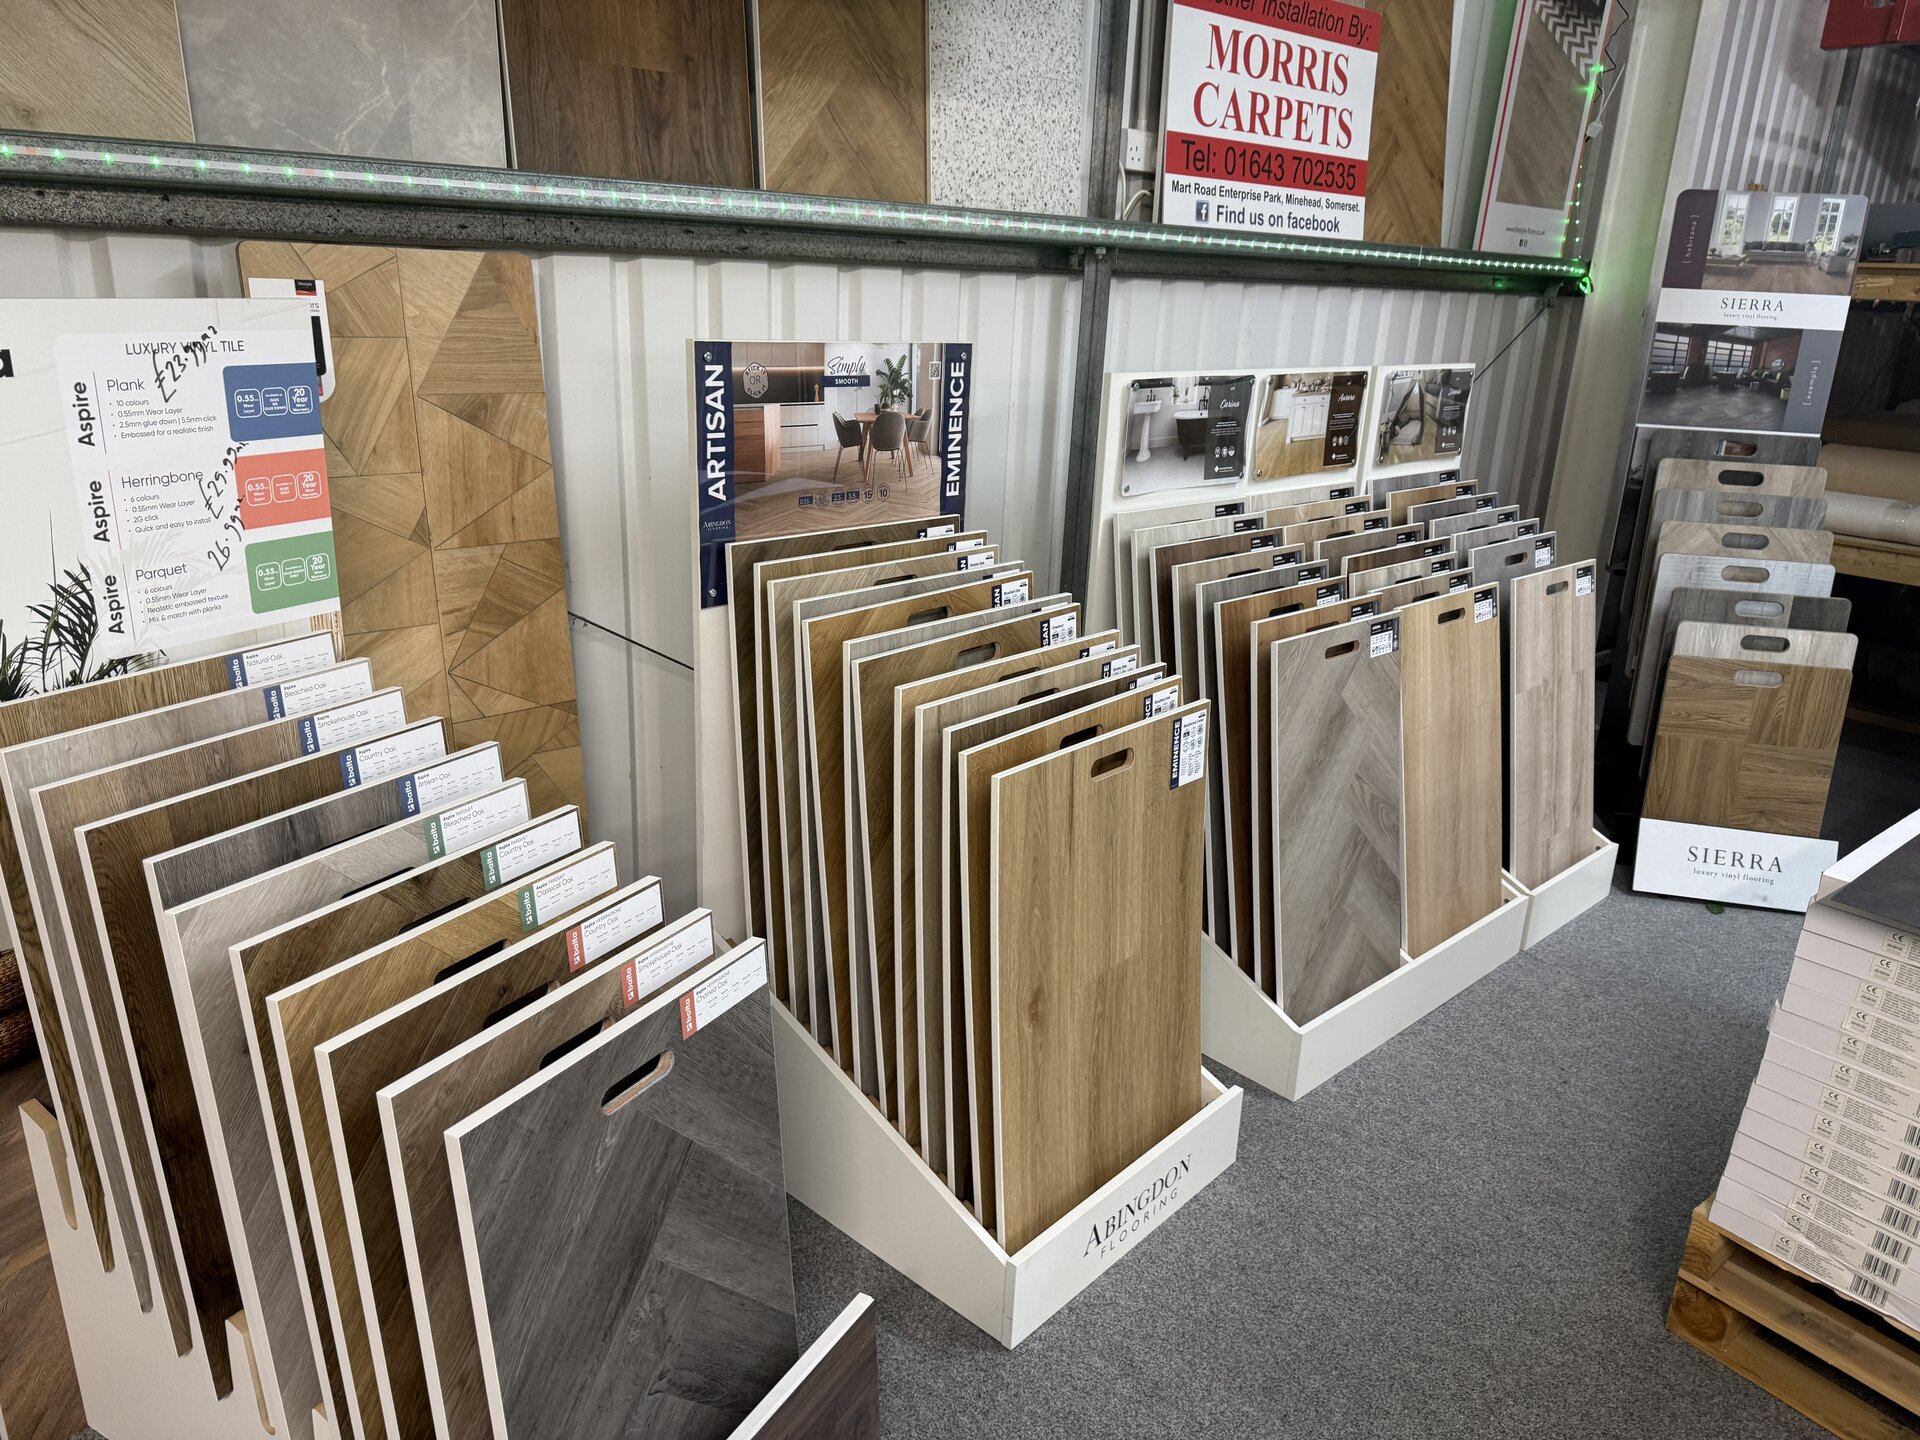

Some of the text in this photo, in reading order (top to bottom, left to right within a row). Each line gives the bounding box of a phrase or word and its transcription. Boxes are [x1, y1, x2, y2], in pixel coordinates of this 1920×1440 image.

[1261, 0, 1372, 45] Installation By:
[1206, 23, 1350, 96] MORRIS
[1193, 81, 1353, 150] CARPETS
[1181, 139, 1356, 191] Tel: 01643 702535
[1171, 180, 1361, 213] Mart Road Enterprise Park, Minehead, Somerset.
[1216, 204, 1340, 233] Find us on facebook
[1720, 297, 1784, 312] SIERRA
[125, 342, 177, 355] LUXURY
[219, 340, 245, 352] TILE
[827, 355, 866, 377] Simply
[106, 378, 146, 392] Plank
[749, 375, 761, 385] OR
[125, 399, 150, 407] colours
[292, 387, 309, 403] 20 Year
[72, 381, 96, 447] Aspire
[117, 407, 183, 418] 0.55mm Wear Layer
[119, 414, 217, 429] 2.5mm glue down 5.5mm click
[120, 430, 156, 439] Embossed
[172, 427, 197, 435] realistic
[197, 425, 214, 433] finish
[704, 364, 727, 501] ARTISAN
[946, 361, 965, 497] EMINENCE
[121, 471, 204, 489] Herringbone
[301, 474, 317, 489] 20 Year
[135, 493, 160, 502] colours
[880, 489, 888, 498] 10
[88, 480, 110, 543] Aspire
[131, 499, 196, 513] 0.55mm Wear Layer
[133, 514, 159, 524] 2G click
[134, 524, 154, 534] Quick
[155, 522, 169, 530] and
[169, 521, 185, 530] easy
[193, 517, 212, 525] install
[135, 563, 188, 581] Parquet
[310, 556, 326, 572] 20 Year
[145, 588, 207, 604] 0.55mm Wear Layer
[149, 585, 173, 593] colours
[103, 575, 125, 634] Aspire
[147, 593, 229, 614] Realistic embossed texture
[148, 616, 161, 624] Mix
[166, 610, 188, 620] match
[188, 608, 202, 616] with
[202, 604, 222, 614] planks
[233, 659, 242, 683] balta
[246, 654, 283, 667] Natural Oak
[270, 690, 280, 714] balta
[284, 686, 313, 698] Bleached
[317, 709, 369, 728] Smokehouse Oak
[304, 721, 314, 745] balta
[359, 745, 397, 762] Country Oak
[1171, 720, 1181, 779] EMINENCE
[346, 755, 355, 779] balta
[417, 772, 451, 788] Artisan Oak
[405, 780, 414, 804] balta
[443, 808, 485, 829] Bleached Oak
[430, 822, 440, 847] balta
[499, 838, 535, 858] Country Oak
[486, 852, 495, 876] balta
[1687, 845, 1784, 874] SIERRA
[536, 876, 574, 898] Classical Oak
[1693, 867, 1775, 886] luxury vinyl flooring
[524, 892, 532, 916] balta
[584, 923, 607, 938] Country
[606, 915, 619, 926] Oak
[572, 931, 580, 957] balta
[638, 950, 672, 973] Smokehouse
[671, 943, 683, 953] Oak
[626, 967, 634, 993] balta
[696, 986, 718, 1004] Charred
[717, 979, 728, 989] Oak
[1083, 1153, 1192, 1258] ABINGDON
[1100, 1187, 1178, 1259] FLOORING
